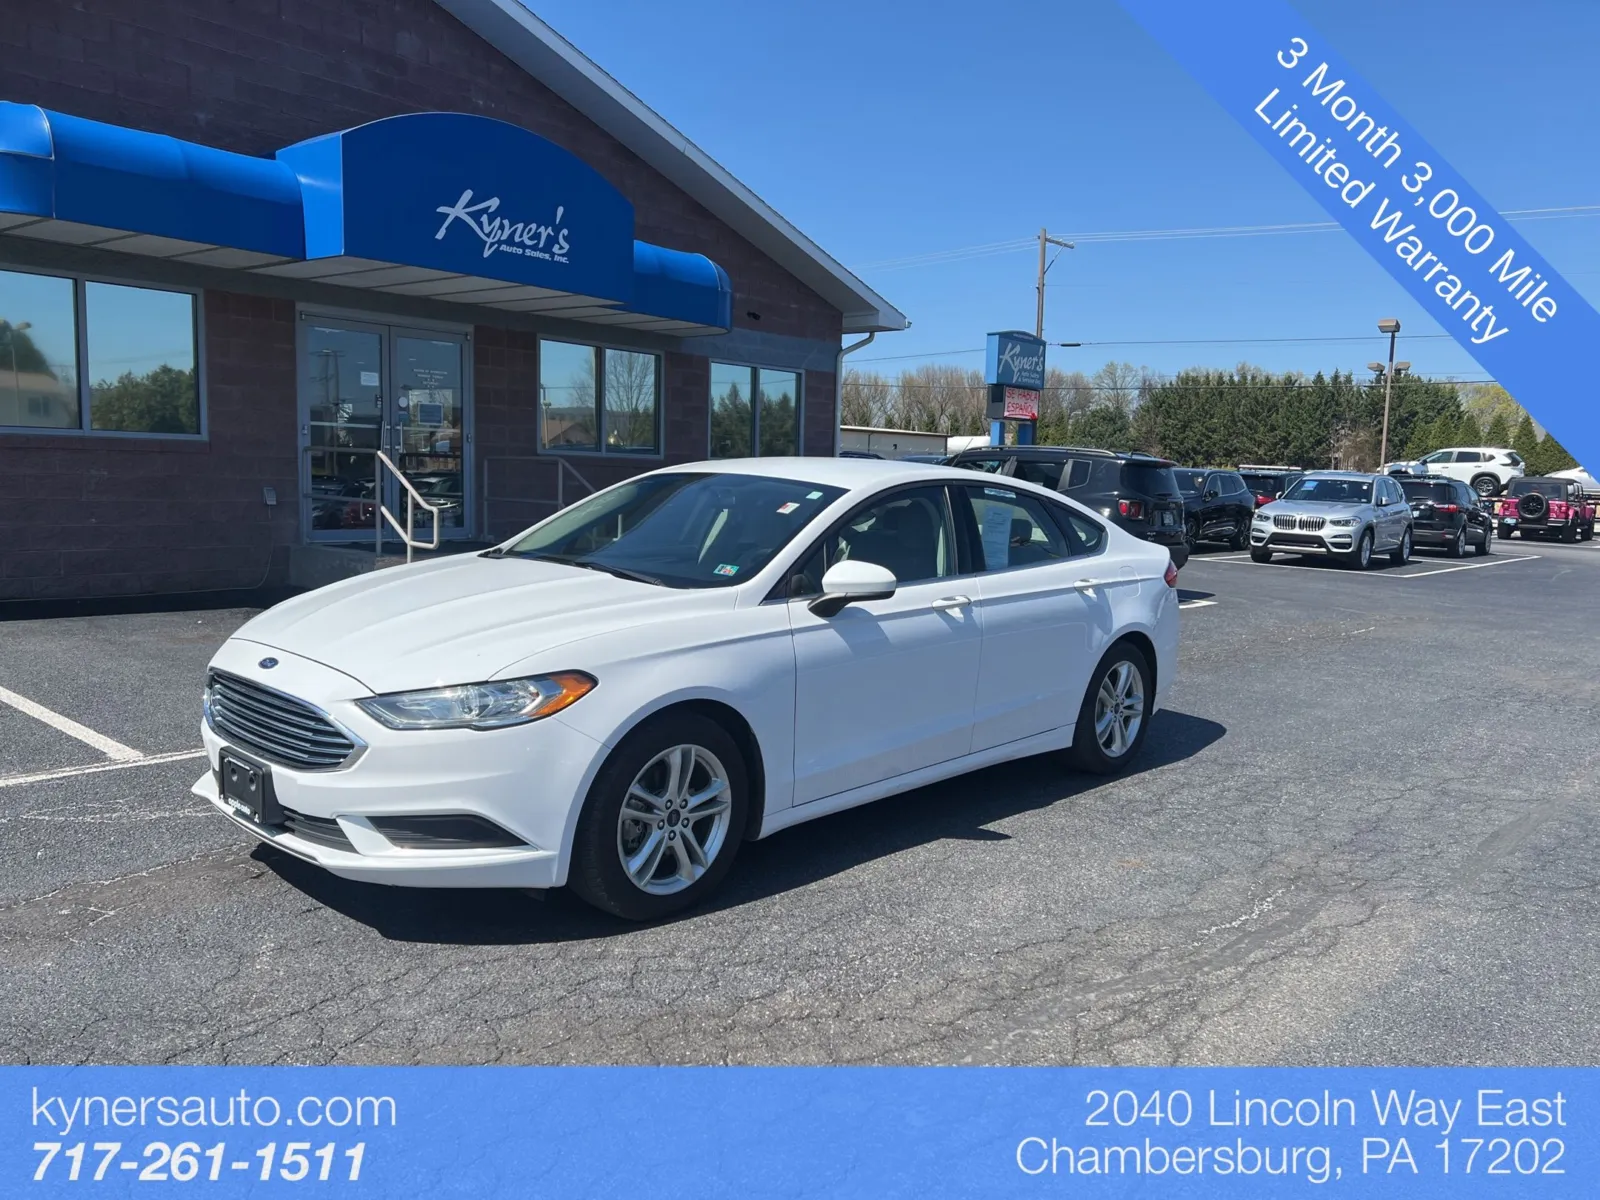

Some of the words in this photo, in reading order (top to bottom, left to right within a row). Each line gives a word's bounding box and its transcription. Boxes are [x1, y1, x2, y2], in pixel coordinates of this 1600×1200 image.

[435, 189, 570, 258] Kyner's
[500, 244, 523, 255] Auto
[525, 249, 552, 261] Sales,
[553, 254, 570, 264] Inc.
[999, 343, 1043, 383] Kyner's
